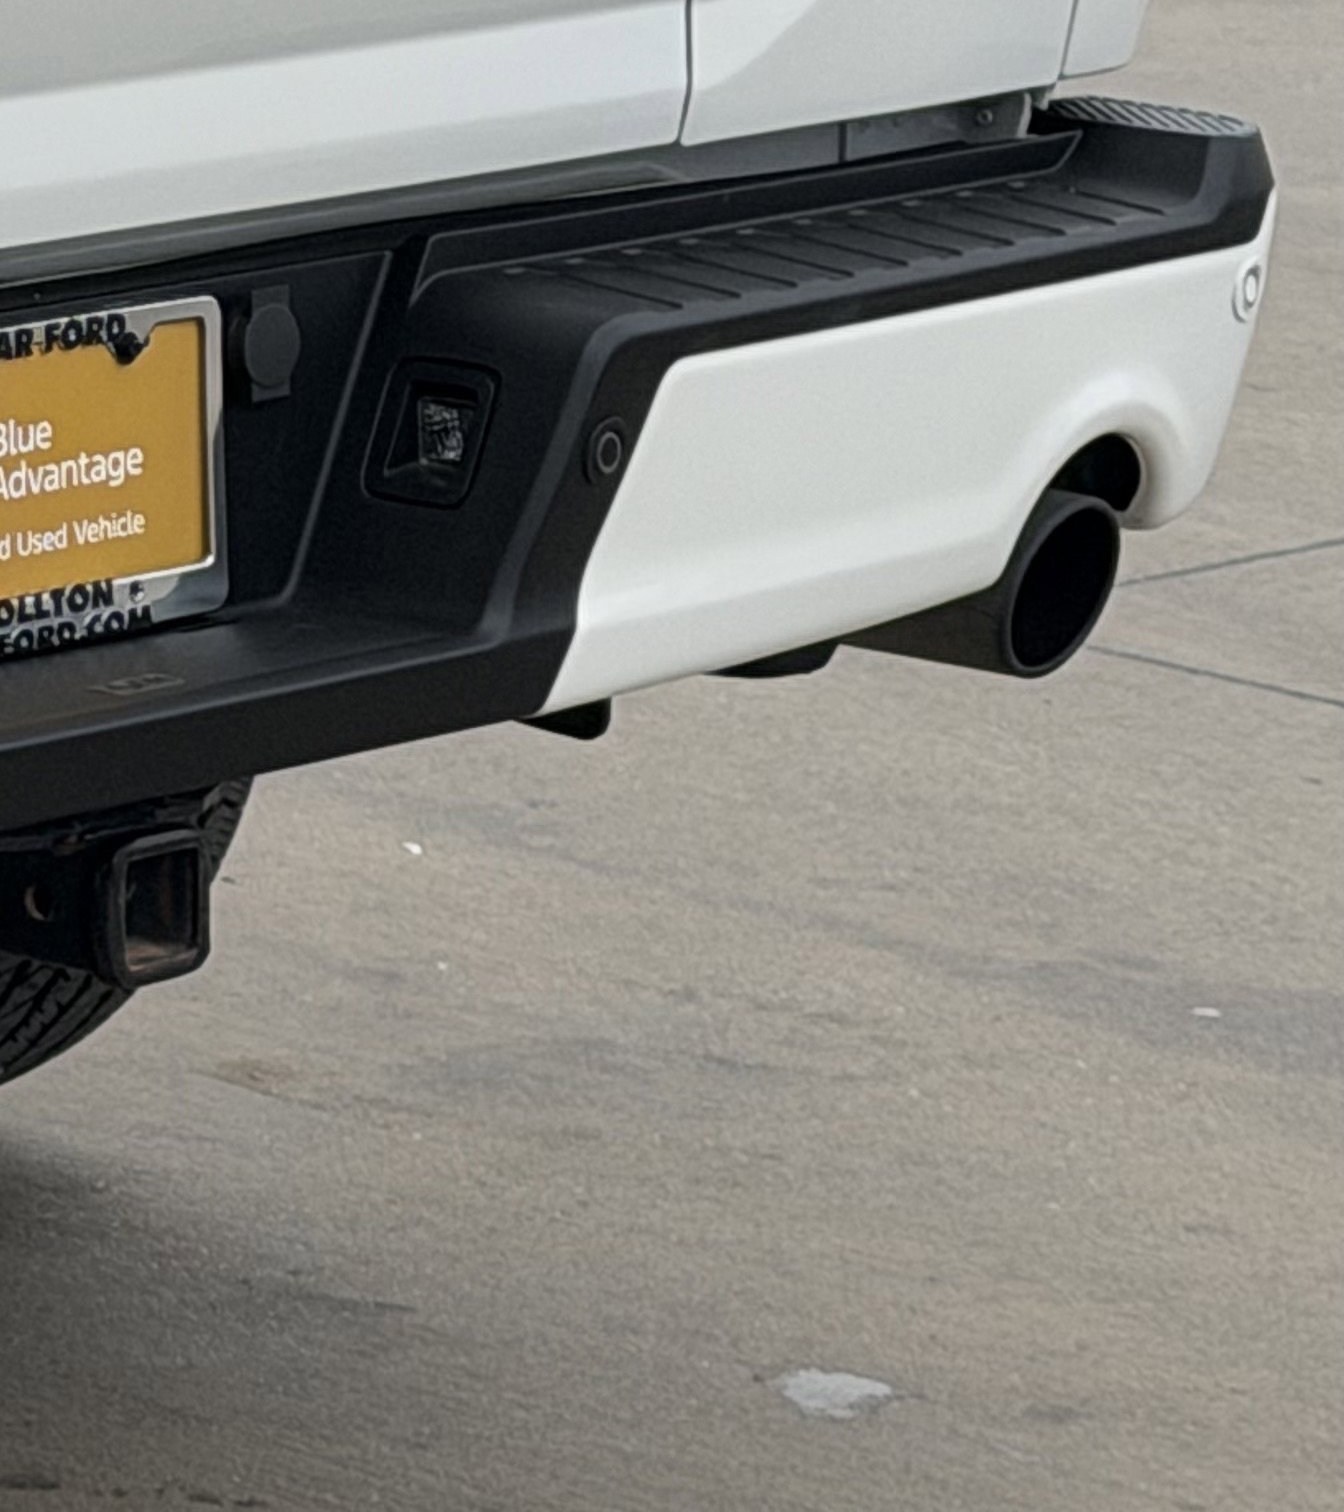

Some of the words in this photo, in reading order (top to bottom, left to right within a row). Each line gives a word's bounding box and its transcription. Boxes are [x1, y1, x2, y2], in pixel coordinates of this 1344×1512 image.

[44, 312, 127, 356] FORD
[16, 521, 68, 558] Used
[72, 510, 146, 545] Vehicle
